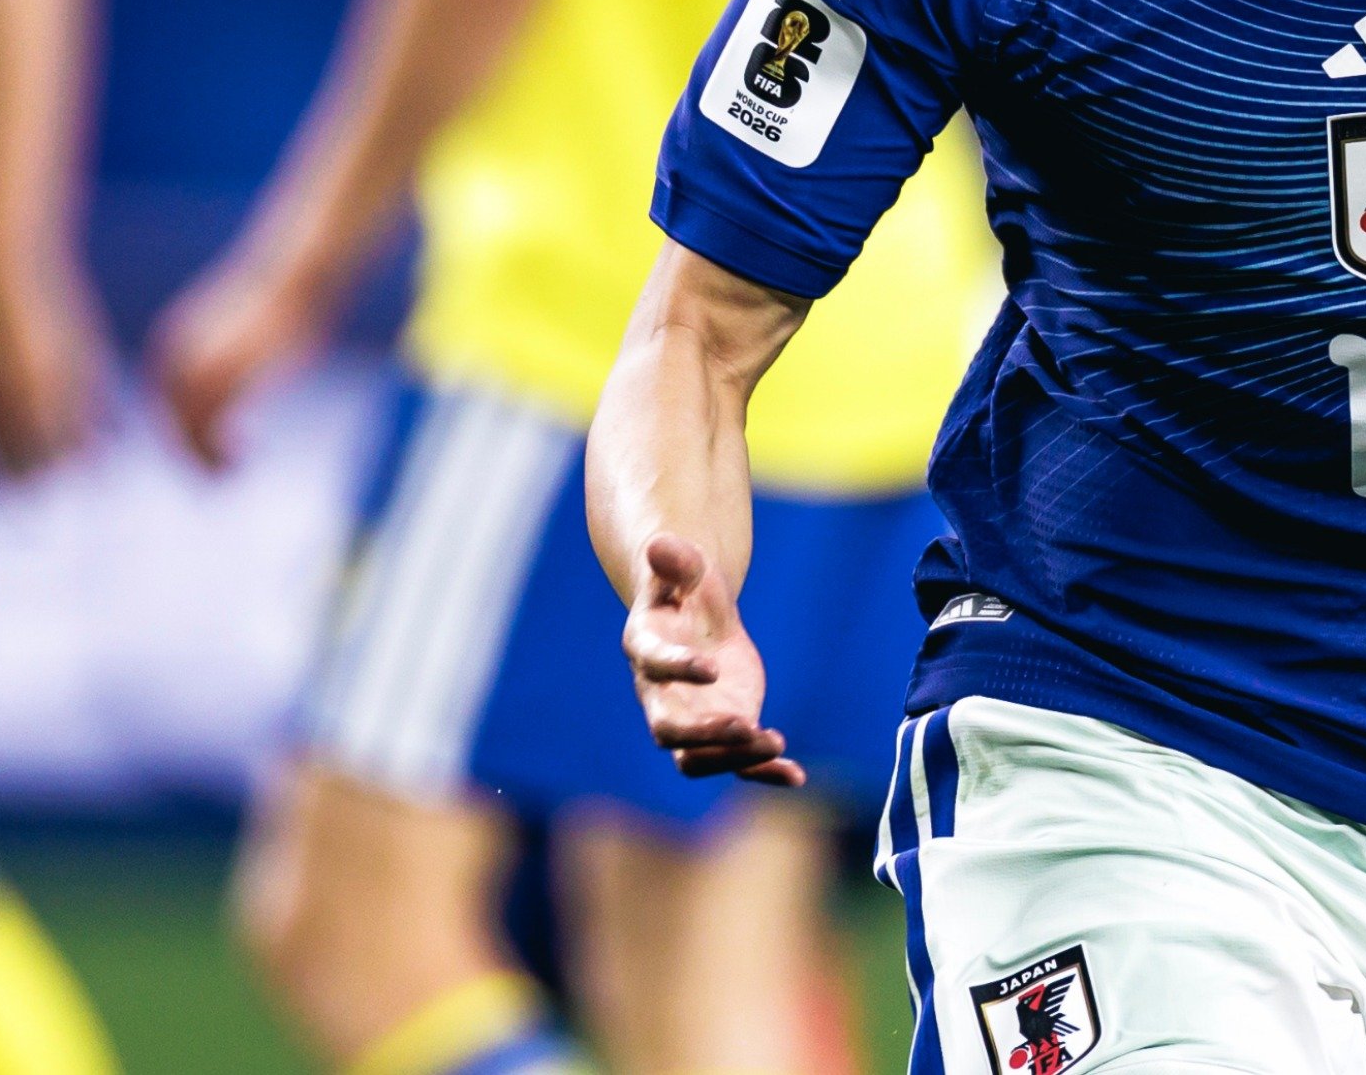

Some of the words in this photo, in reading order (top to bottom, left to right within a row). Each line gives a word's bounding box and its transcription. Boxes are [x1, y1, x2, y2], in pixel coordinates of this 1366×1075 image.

[753, 73, 782, 99] FIFA
[727, 101, 782, 143] 2026
[736, 89, 765, 115] WORLD
[764, 108, 788, 126] CUP
[999, 959, 1058, 995] JAPAN
